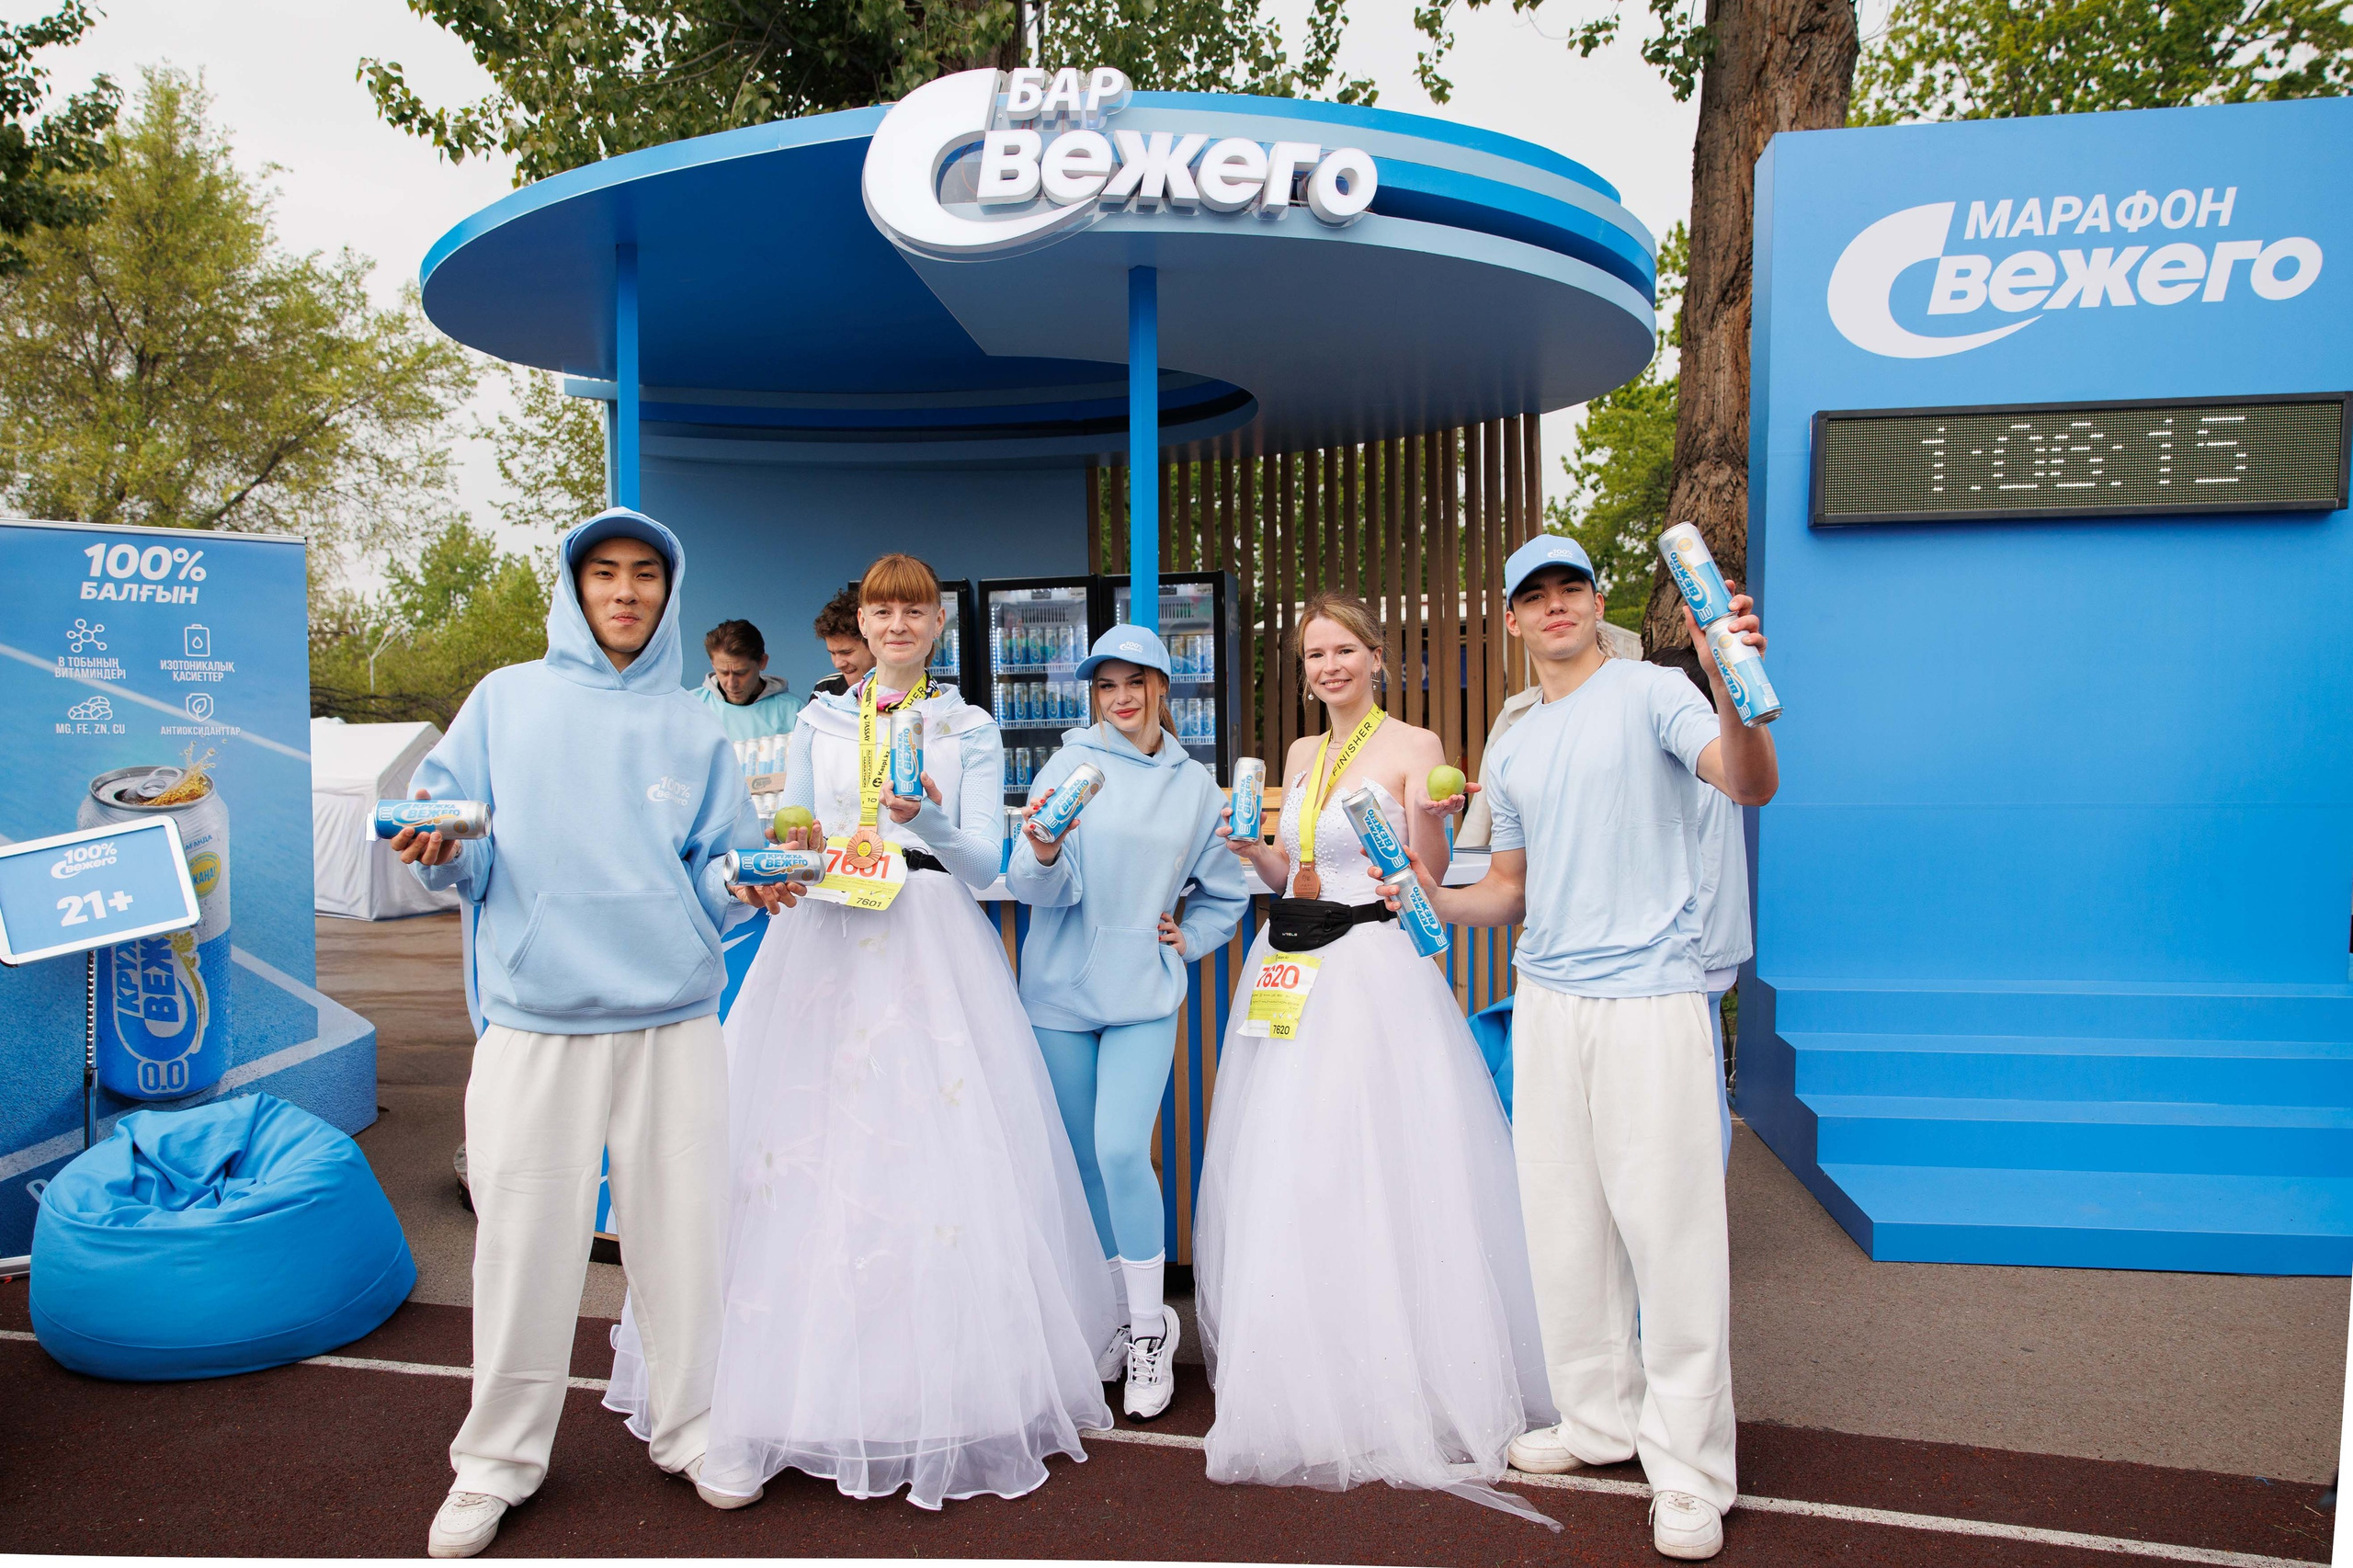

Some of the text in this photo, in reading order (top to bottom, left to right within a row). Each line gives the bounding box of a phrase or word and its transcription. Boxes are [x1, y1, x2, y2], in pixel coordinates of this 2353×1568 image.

[1006, 67, 1126, 121] БАР
[1963, 187, 2237, 240] МАРАФОН
[1921, 416, 2245, 492] 1:08:15
[84, 542, 207, 582] 100%
[79, 581, 199, 604] БАЛҒЫН
[55, 666, 127, 680] ВИТАМИНДЕРІ
[58, 656, 119, 669] В ТОБЫНЫҢ
[160, 659, 235, 673] ИЗОТОНИКАЛЫҚ
[172, 671, 224, 683] ҚАСИЕТТЕР
[113, 724, 126, 735] CU
[160, 725, 241, 736] АНТИОКСИДАНТТАР
[1332, 722, 1373, 777] FINISHER
[877, 750, 891, 777] Kaspi.kz
[660, 776, 690, 798] 100%
[63, 842, 118, 864] 100%
[57, 890, 134, 926] 21+
[856, 897, 882, 908] 7601
[1256, 963, 1301, 990] 7620
[1272, 1024, 1290, 1036] 7620
[142, 1060, 185, 1092] 0.0
